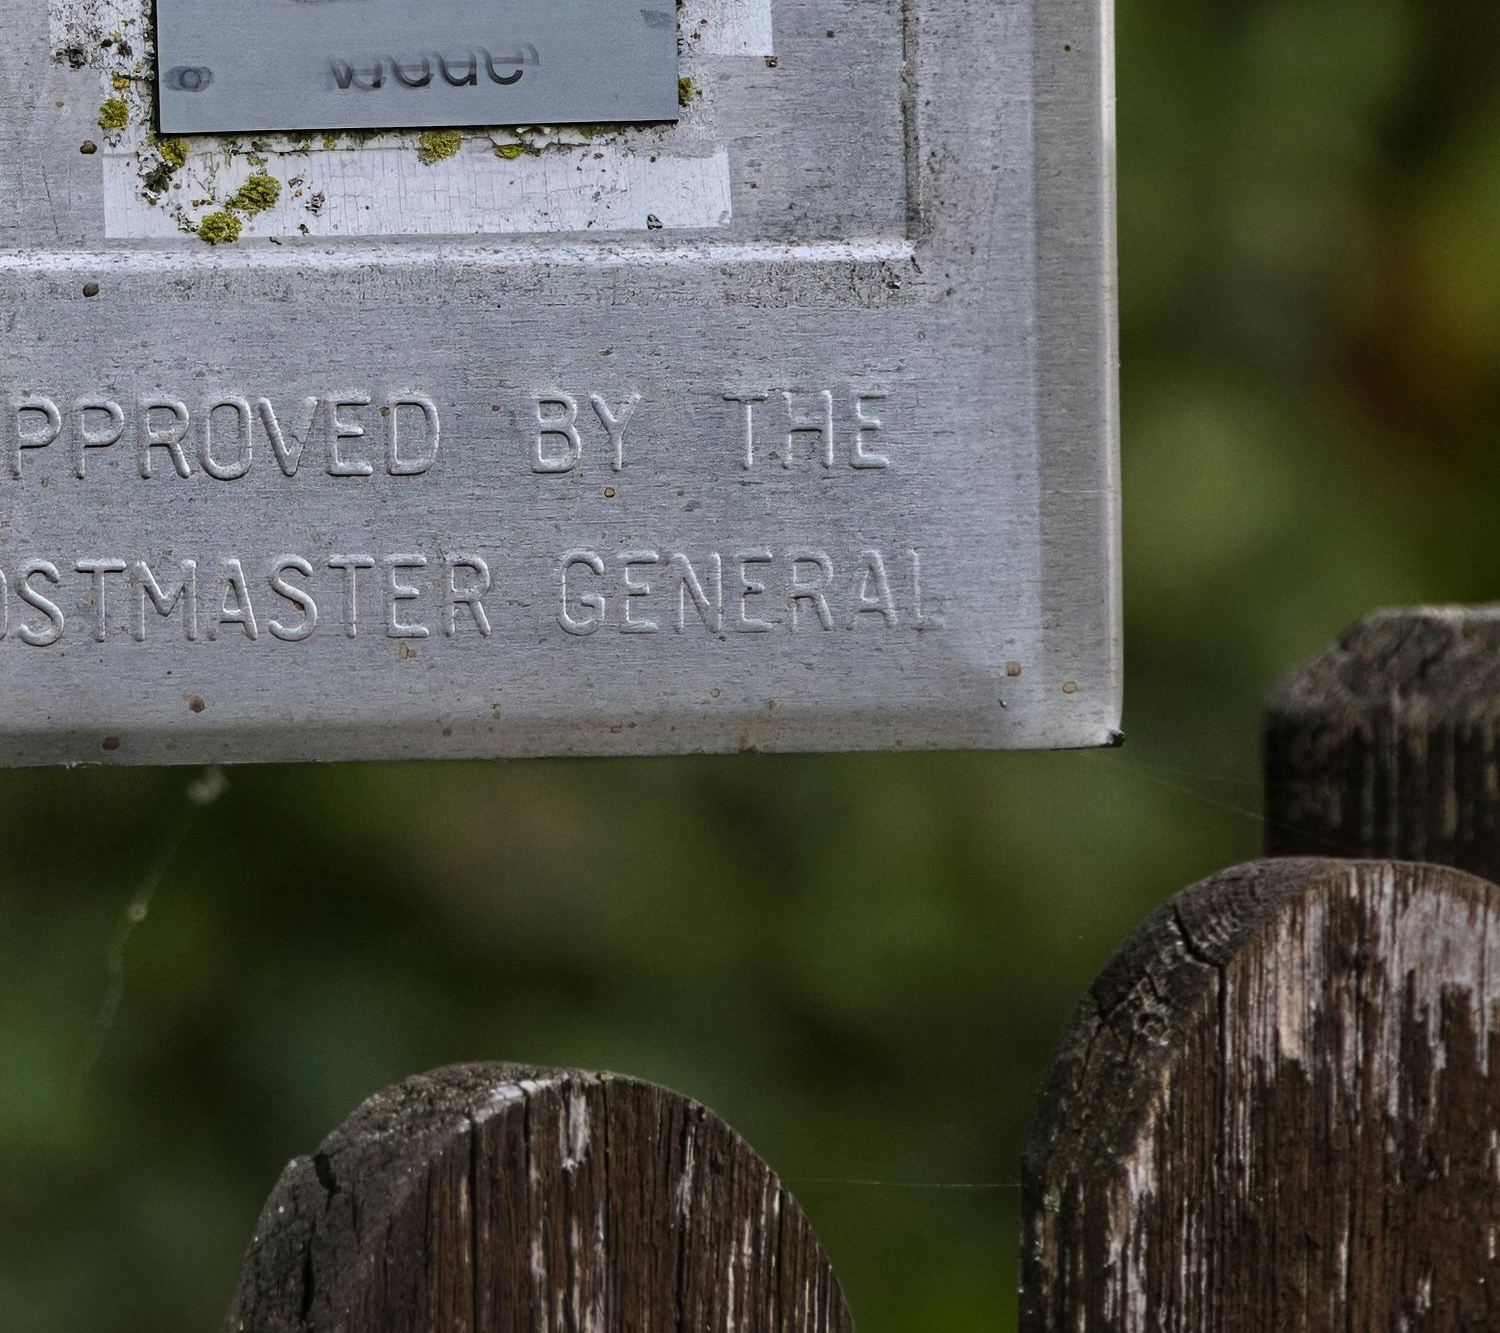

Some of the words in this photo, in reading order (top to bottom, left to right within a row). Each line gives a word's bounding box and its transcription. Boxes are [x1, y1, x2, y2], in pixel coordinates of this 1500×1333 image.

[530, 388, 643, 476] BY
[722, 386, 893, 472] THE
[556, 546, 946, 637] GENERAL
